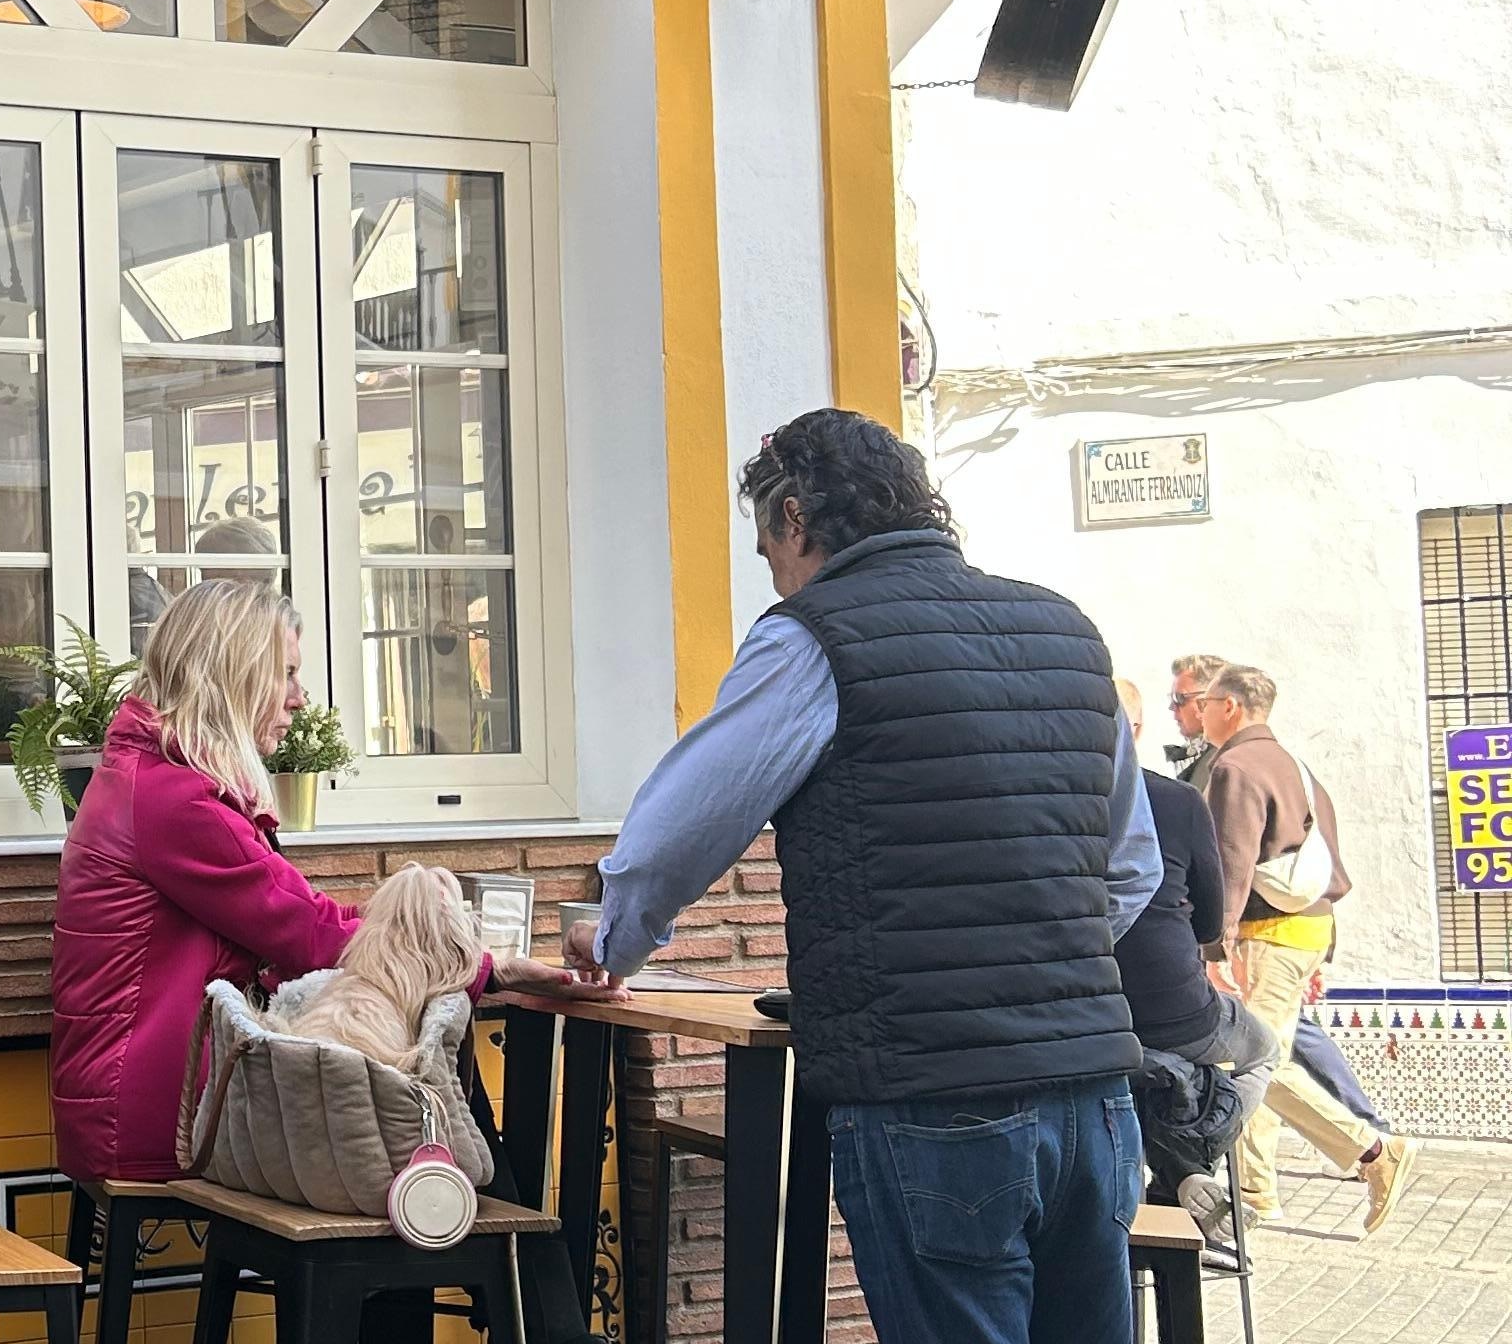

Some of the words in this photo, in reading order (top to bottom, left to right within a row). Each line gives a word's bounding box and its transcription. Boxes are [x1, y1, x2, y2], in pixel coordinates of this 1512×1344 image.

[1104, 450, 1151, 472] CALLE
[1090, 477, 1146, 505] ALMIRANTE
[1459, 773, 1512, 806] SE
[1466, 851, 1512, 884] 95
